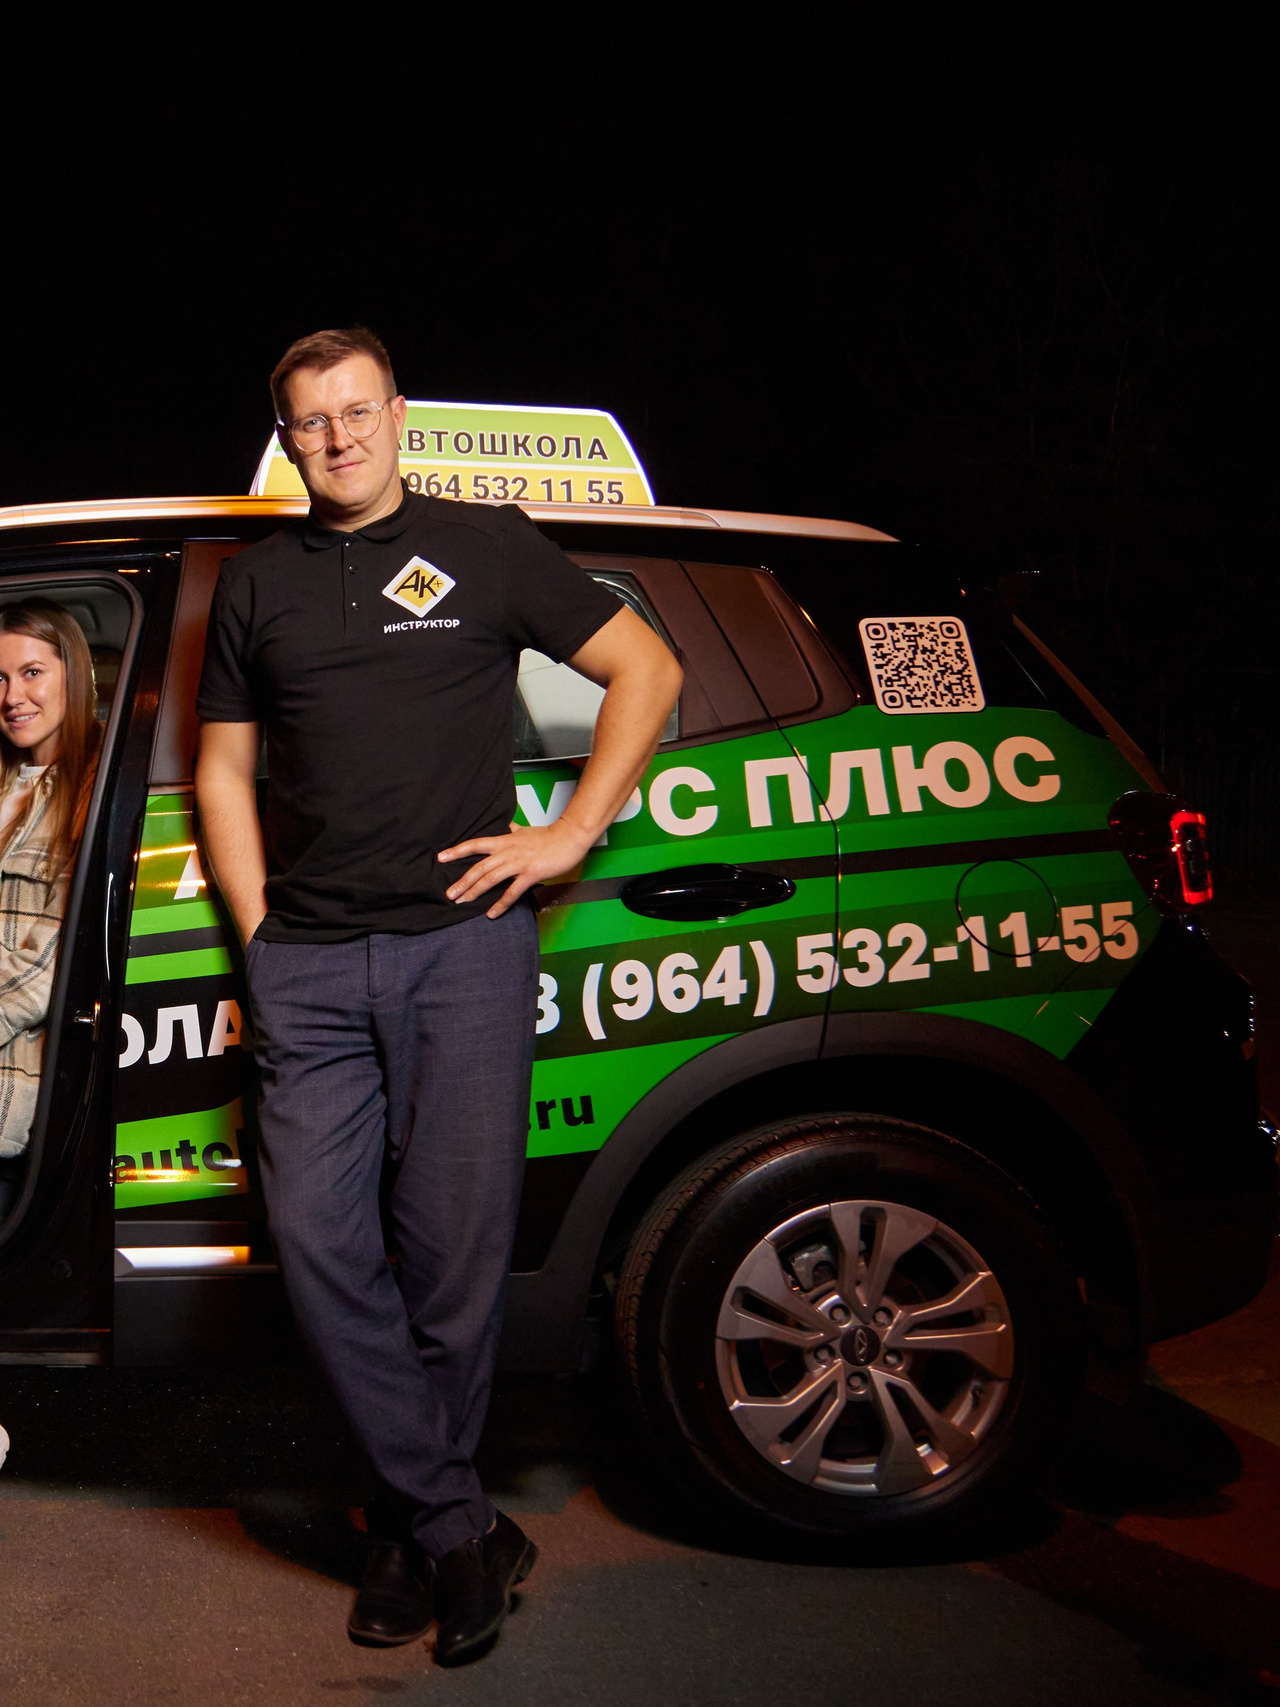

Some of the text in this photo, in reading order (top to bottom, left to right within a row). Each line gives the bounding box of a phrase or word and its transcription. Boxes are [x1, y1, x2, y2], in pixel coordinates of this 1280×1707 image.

[399, 429, 609, 461] ВТОШКОЛА
[406, 472, 624, 504] 964 532 11 55
[383, 619, 460, 634] ИНСТРУКТОР
[744, 736, 1061, 829] ПЛЮС
[582, 940, 775, 1040] (964)
[796, 901, 1139, 995] 532-11-55
[528, 1095, 595, 1130] ru
